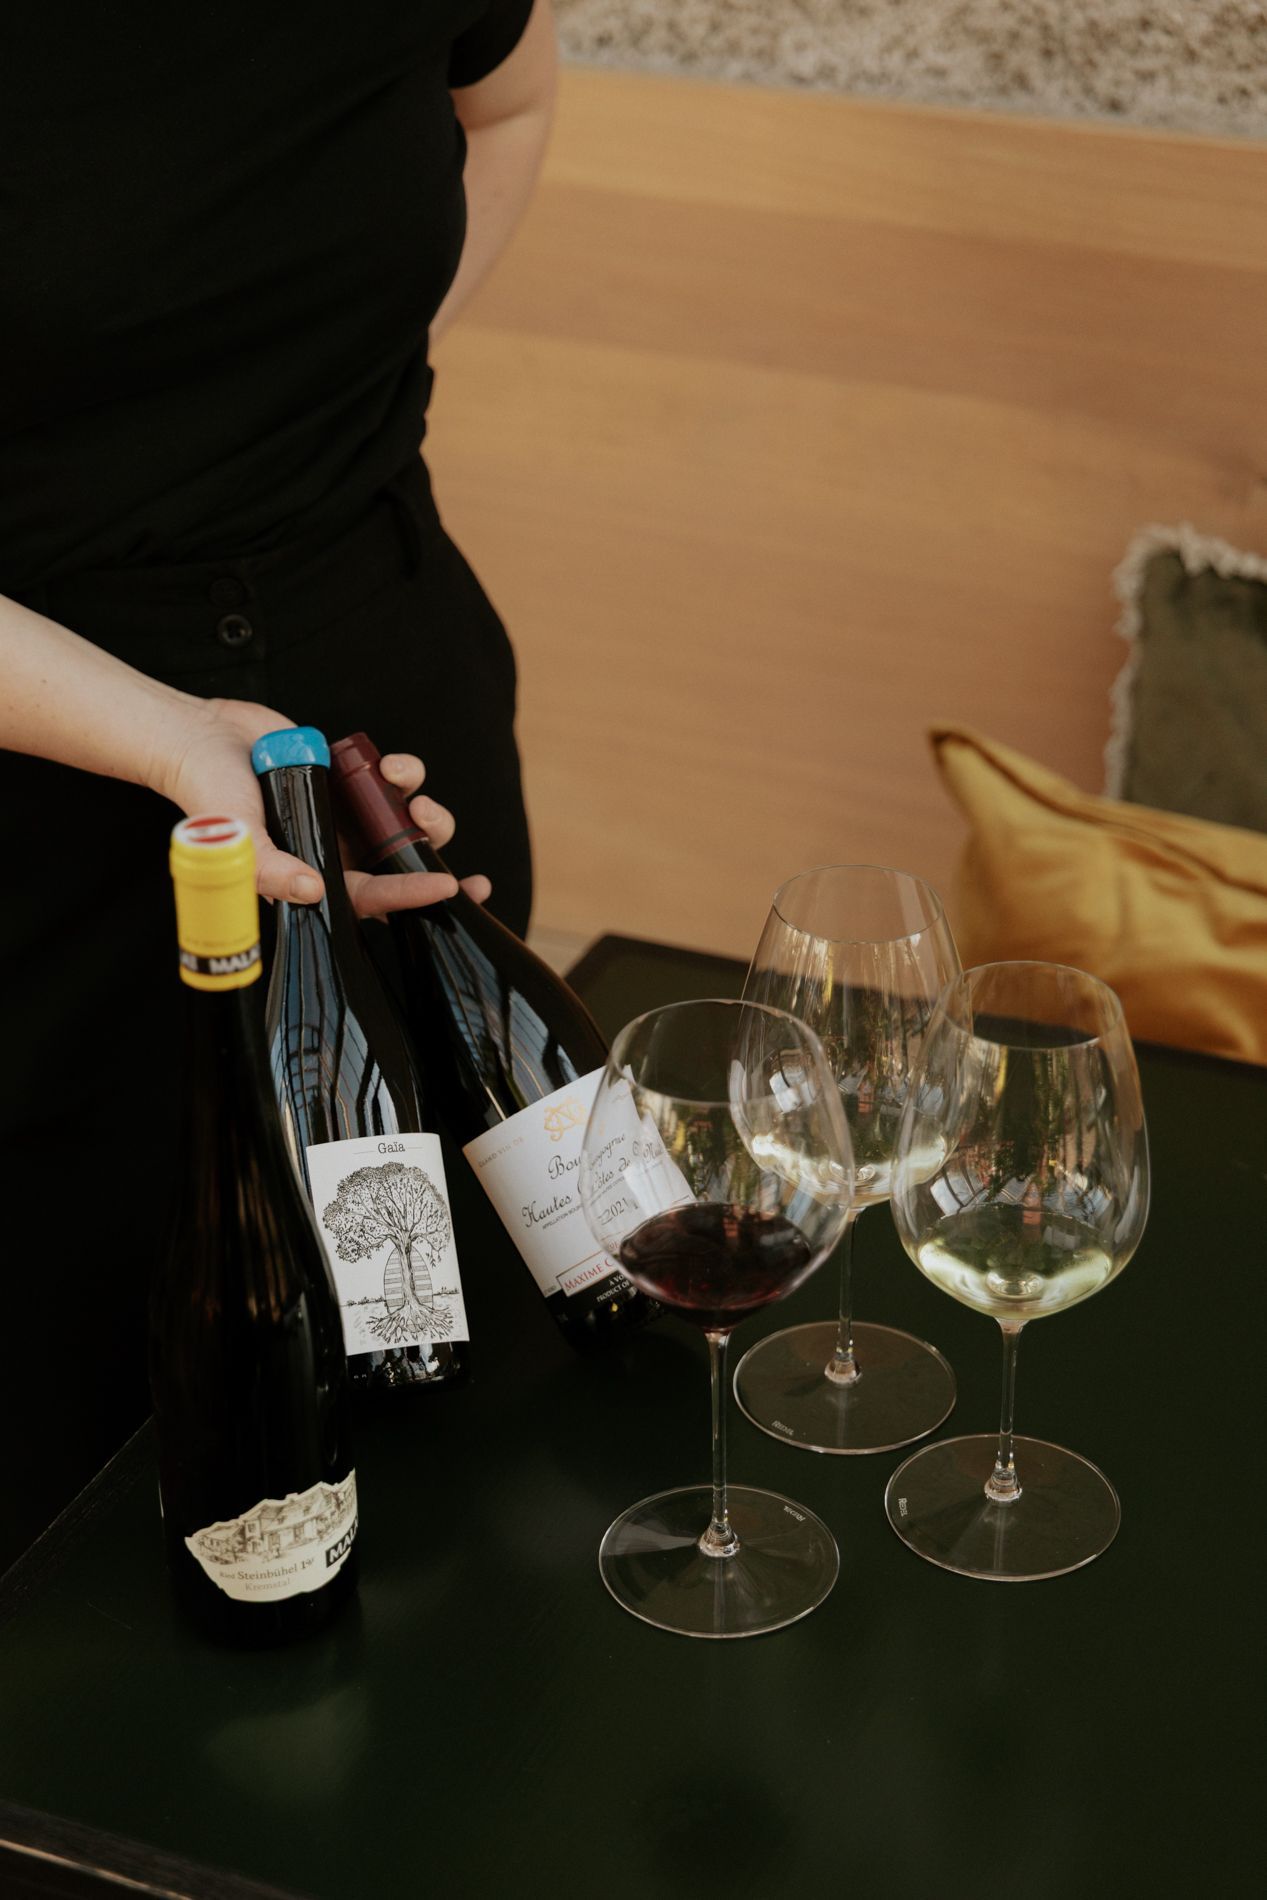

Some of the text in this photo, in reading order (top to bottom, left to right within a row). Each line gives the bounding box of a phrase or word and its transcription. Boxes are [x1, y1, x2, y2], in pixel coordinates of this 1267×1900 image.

[377, 1141, 406, 1154] Gaïa
[521, 1196, 572, 1228] Hautes
[564, 1263, 603, 1290] MAXIME
